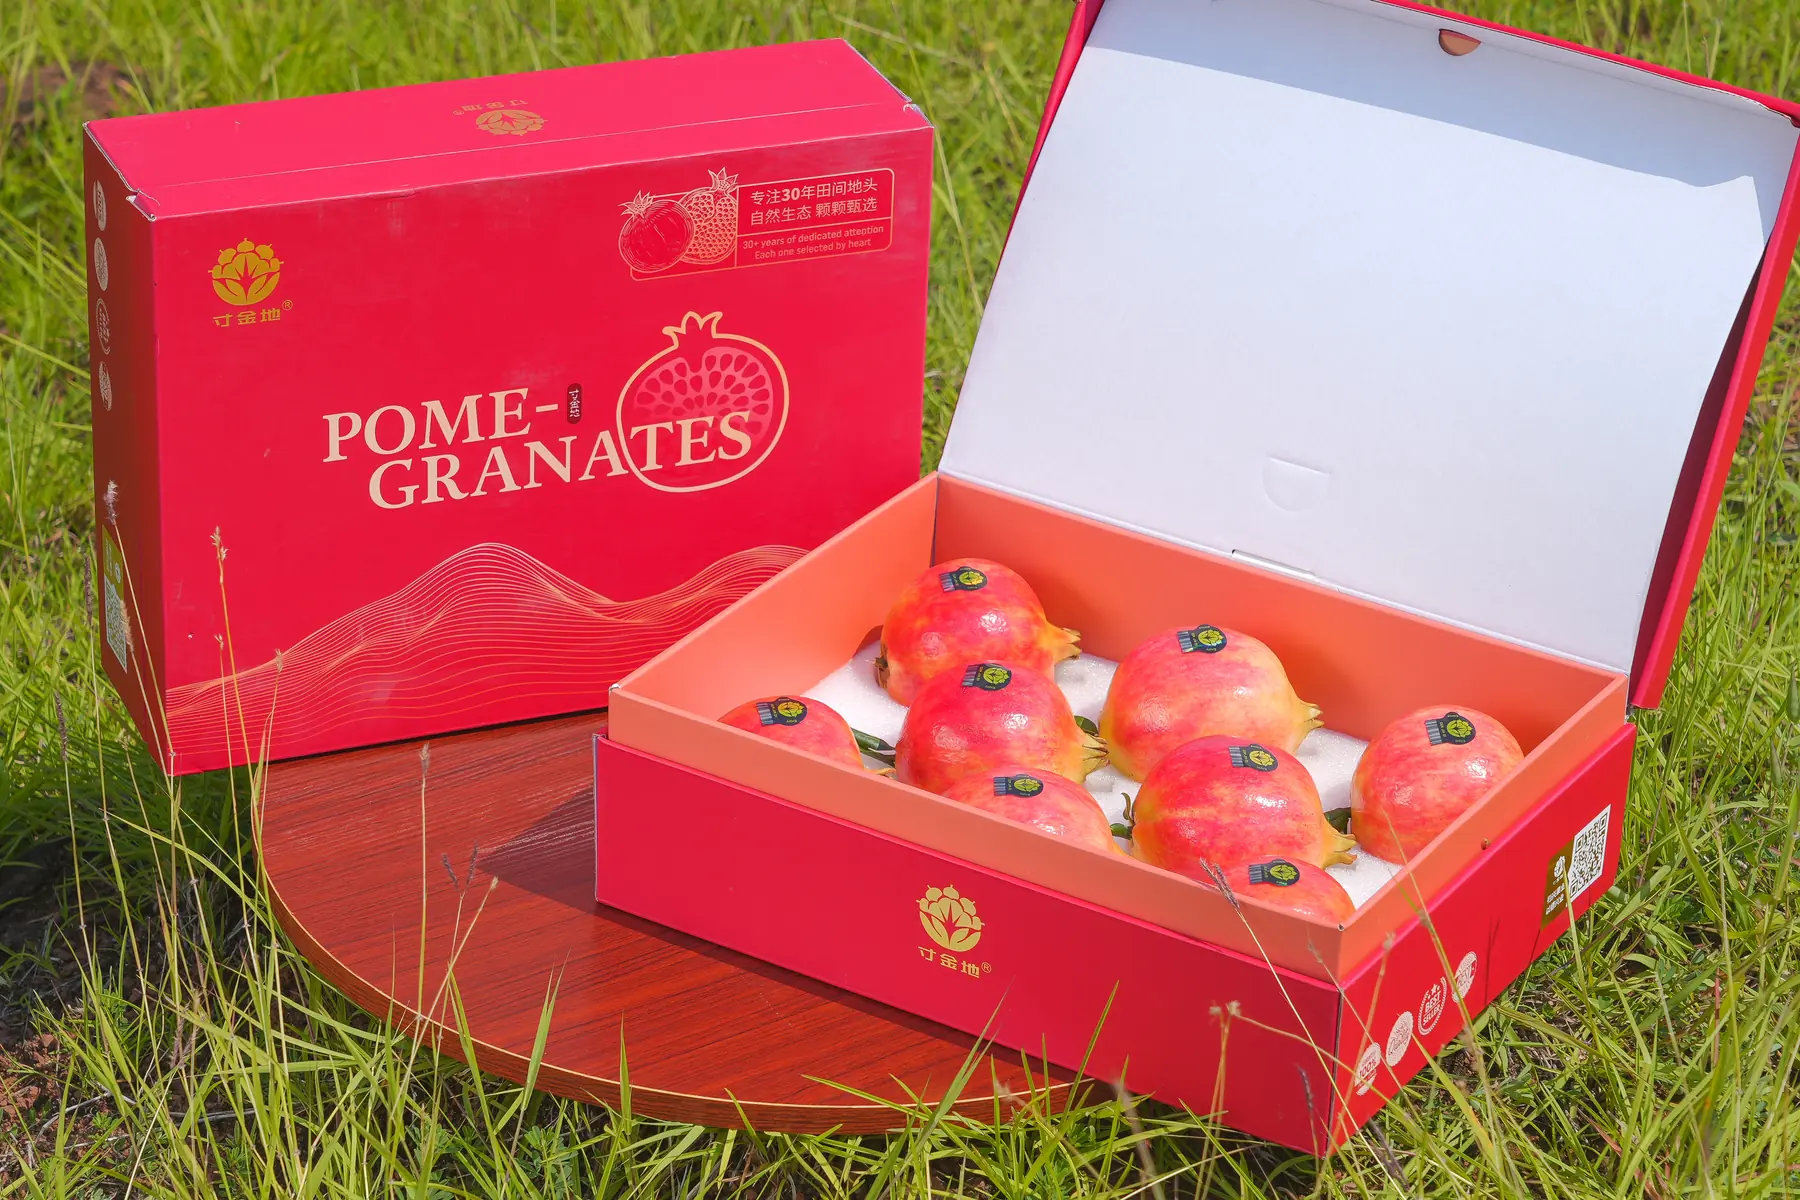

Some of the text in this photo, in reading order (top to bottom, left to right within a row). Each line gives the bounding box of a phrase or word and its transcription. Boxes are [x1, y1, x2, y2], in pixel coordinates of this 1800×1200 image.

[750, 177, 878, 206] 专注30年田间地头
[750, 196, 878, 227] 自然生态 颗颗甄选
[742, 225, 884, 250] 30+ years of dedicated attention
[755, 238, 872, 260] Each one selected by heart
[368, 411, 754, 510] GRANATES
[1424, 990, 1441, 1013] BEST
